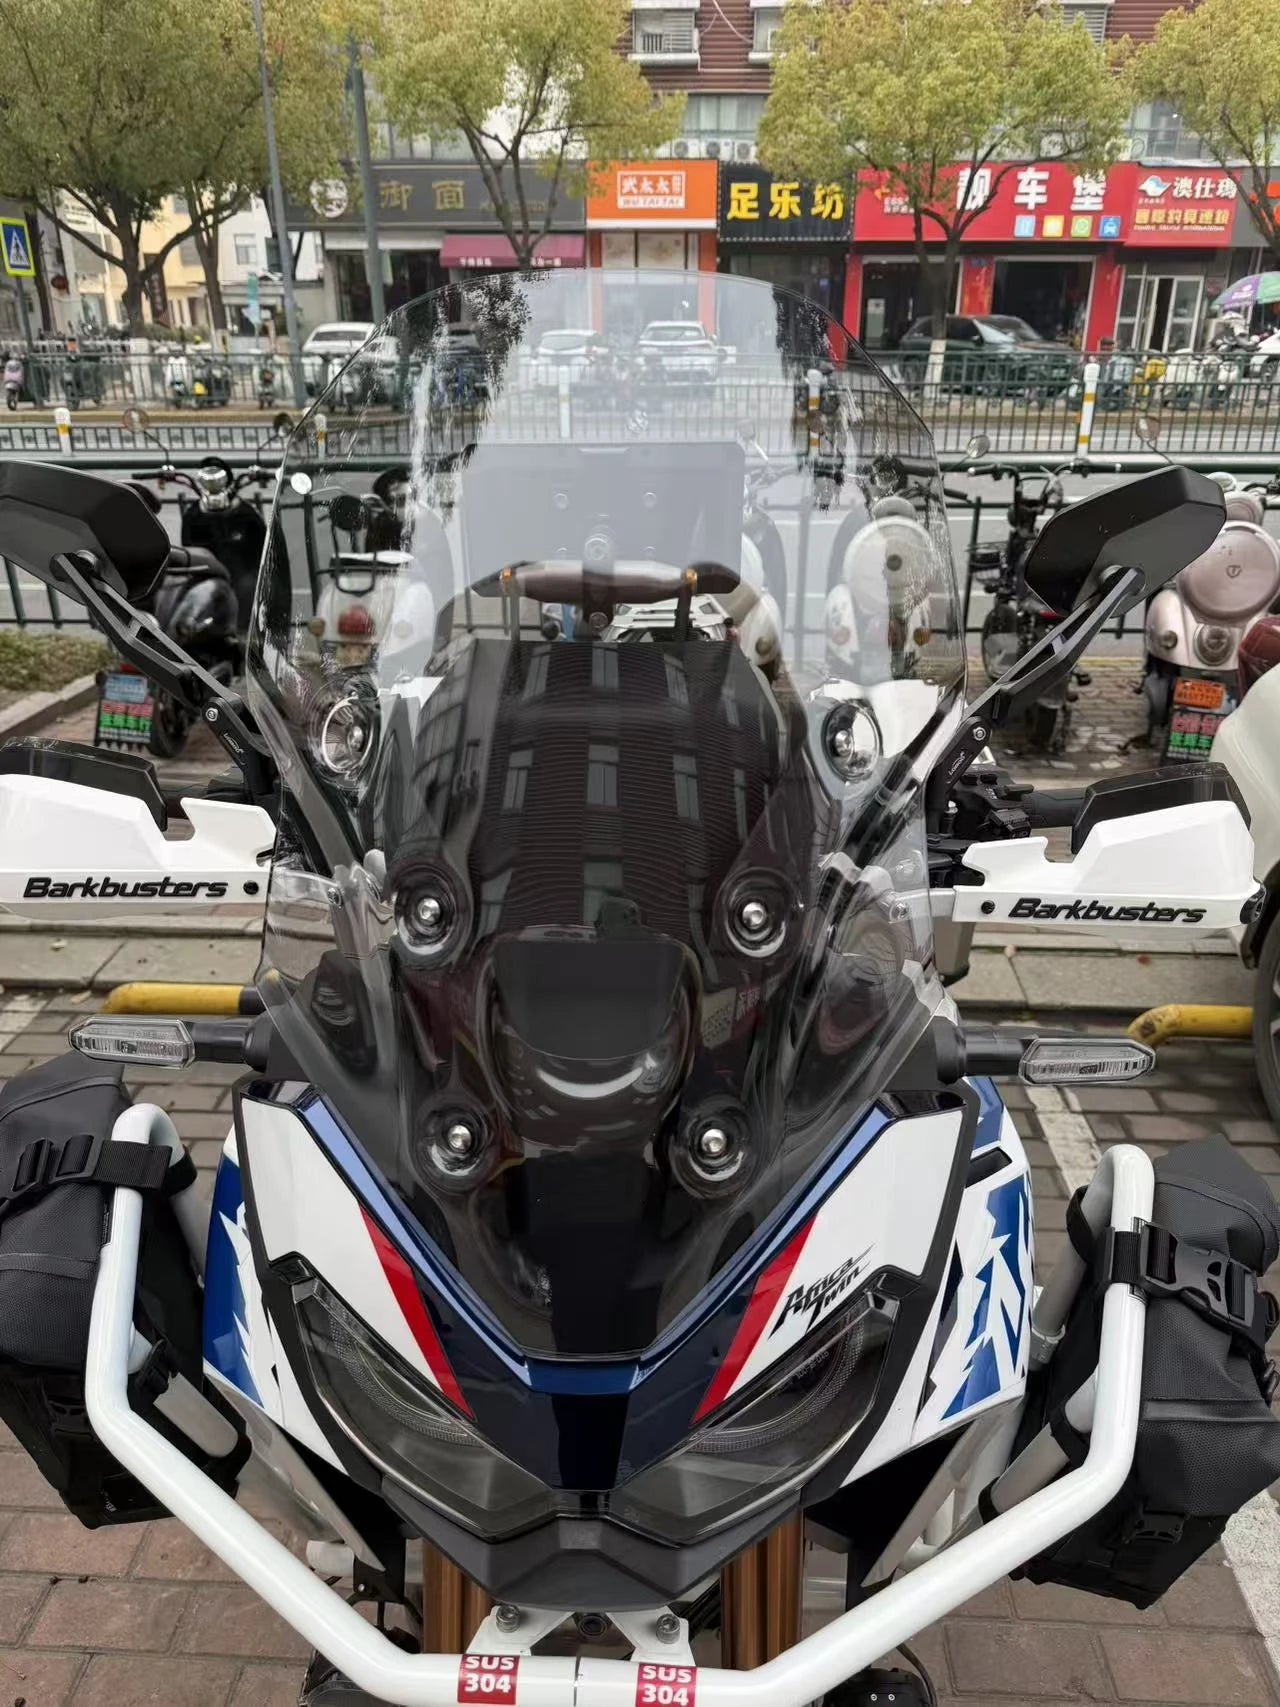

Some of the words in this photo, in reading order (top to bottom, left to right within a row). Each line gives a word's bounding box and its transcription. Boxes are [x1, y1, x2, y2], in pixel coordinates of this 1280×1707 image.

[380, 179, 465, 211] 御面
[726, 181, 845, 220] 足乐坊
[23, 876, 229, 898] Barkbusters
[1008, 897, 1208, 923] Barkbusters
[767, 1252, 862, 1340] Africa
[798, 1264, 864, 1337] Twin
[465, 1656, 515, 1671] SUS
[641, 1665, 693, 1684] SUS
[463, 1673, 512, 1694] 304
[641, 1683, 690, 1707] 304
